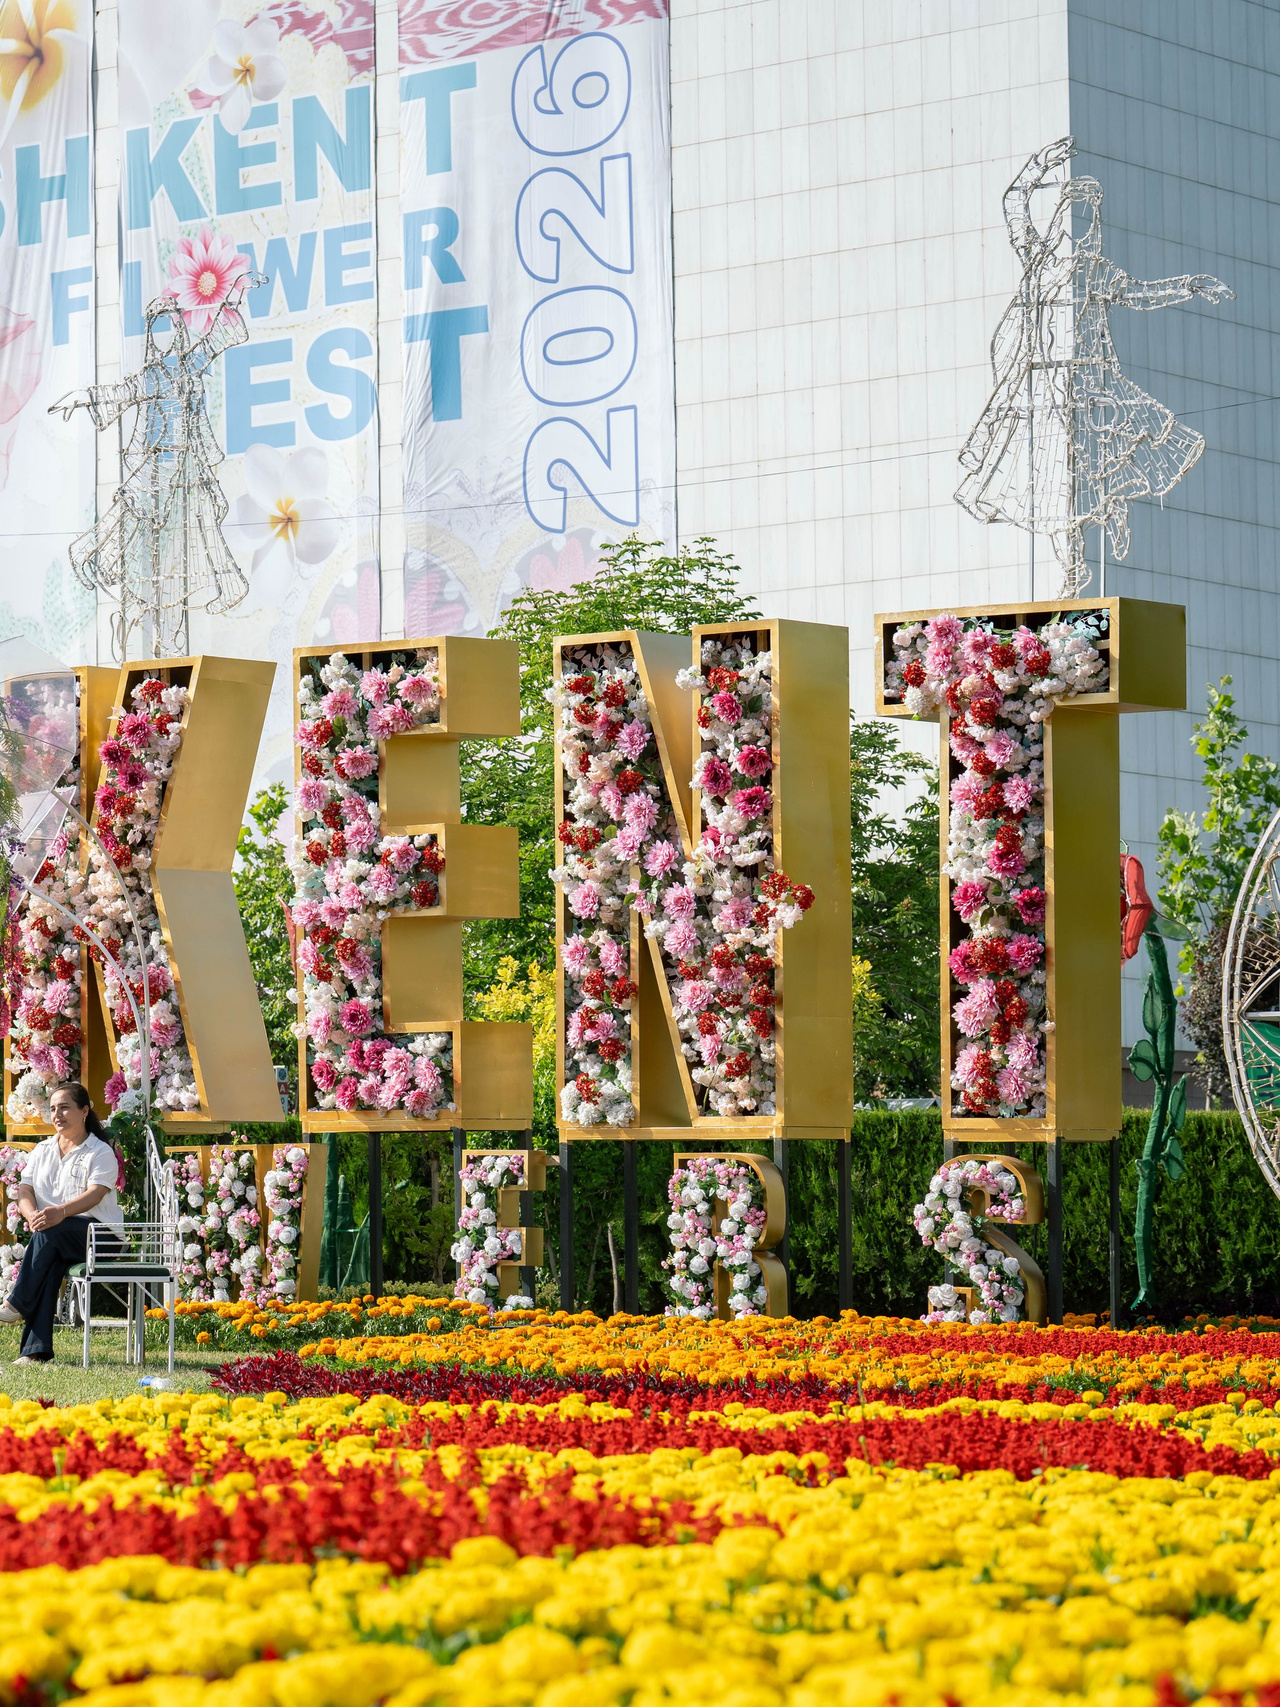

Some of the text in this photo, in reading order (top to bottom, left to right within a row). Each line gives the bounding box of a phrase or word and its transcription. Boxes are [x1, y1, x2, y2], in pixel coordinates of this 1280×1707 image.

[51, 206, 467, 347] FLWER
[511, 31, 640, 534] 2026
[144, 304, 489, 464] FEST
